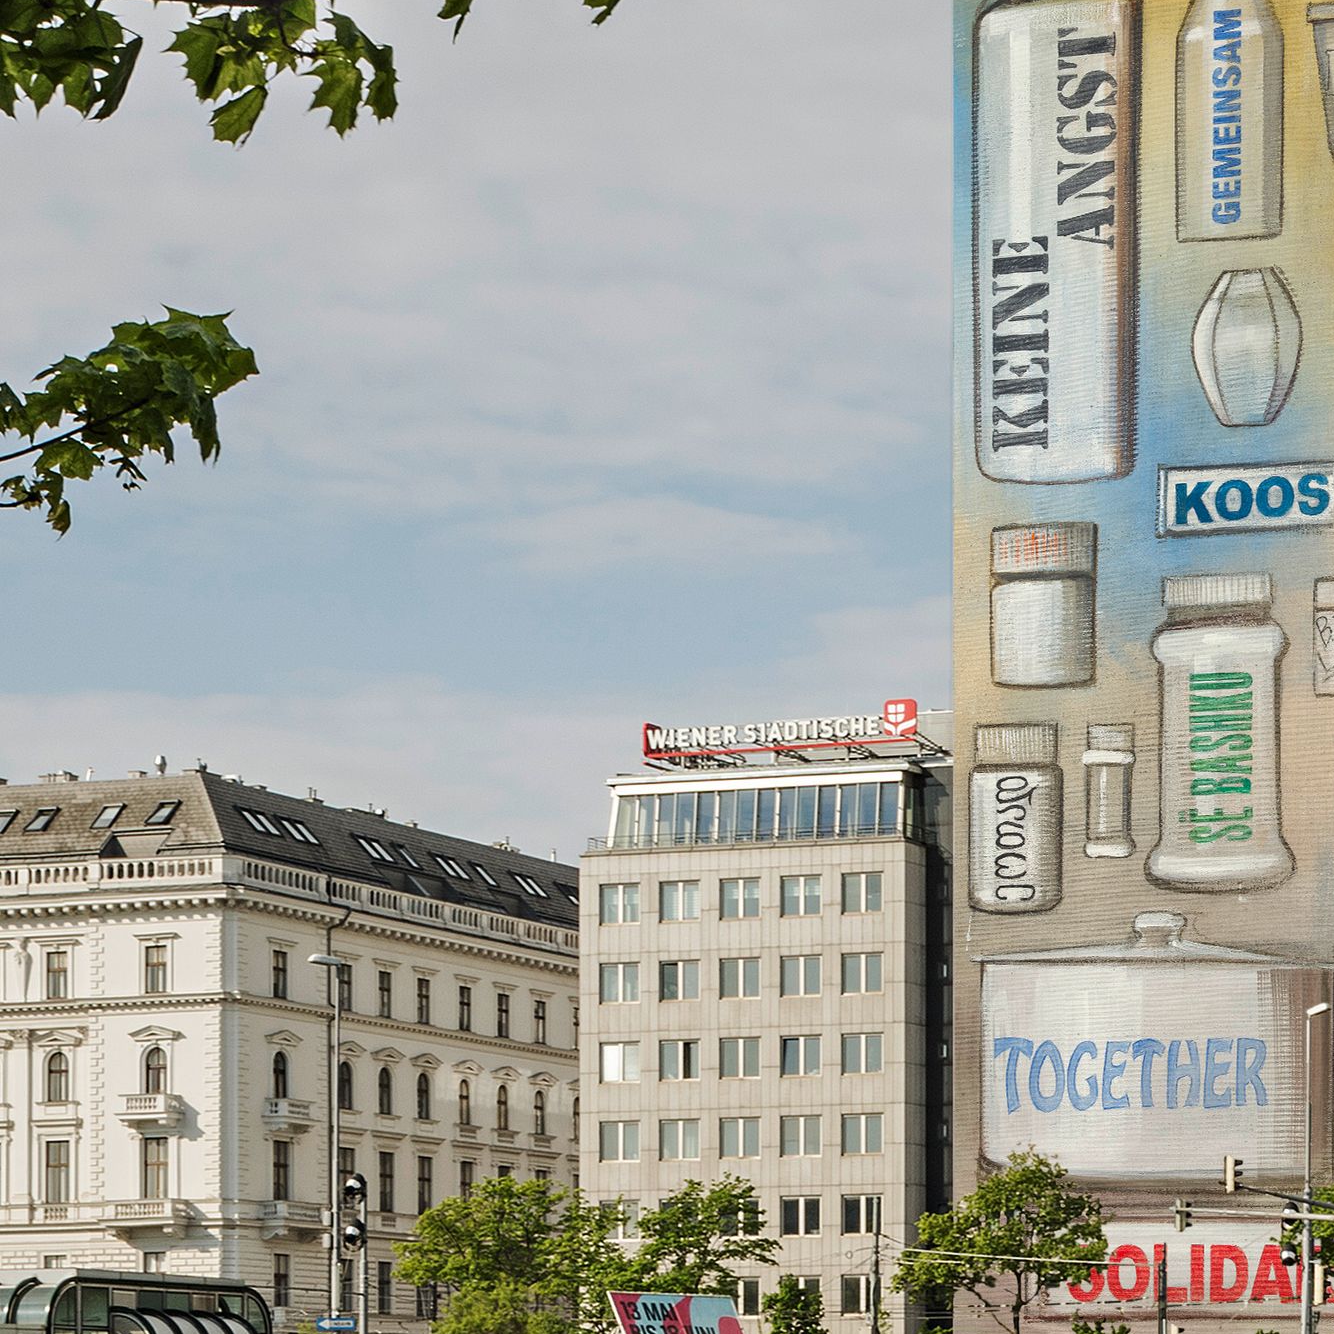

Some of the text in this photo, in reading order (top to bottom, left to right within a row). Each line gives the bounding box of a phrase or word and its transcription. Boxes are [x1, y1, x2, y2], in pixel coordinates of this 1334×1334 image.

[1211, 8, 1243, 226] GEMEINSAM
[992, 27, 1118, 453] KEINE ANGST
[1174, 473, 1332, 527] KOOS
[646, 714, 881, 750] WIENER STÄDTISCHE
[1188, 671, 1254, 796] BASHKU
[993, 1036, 1268, 1116] TOGETHER
[620, 1301, 679, 1322] 13 MAI
